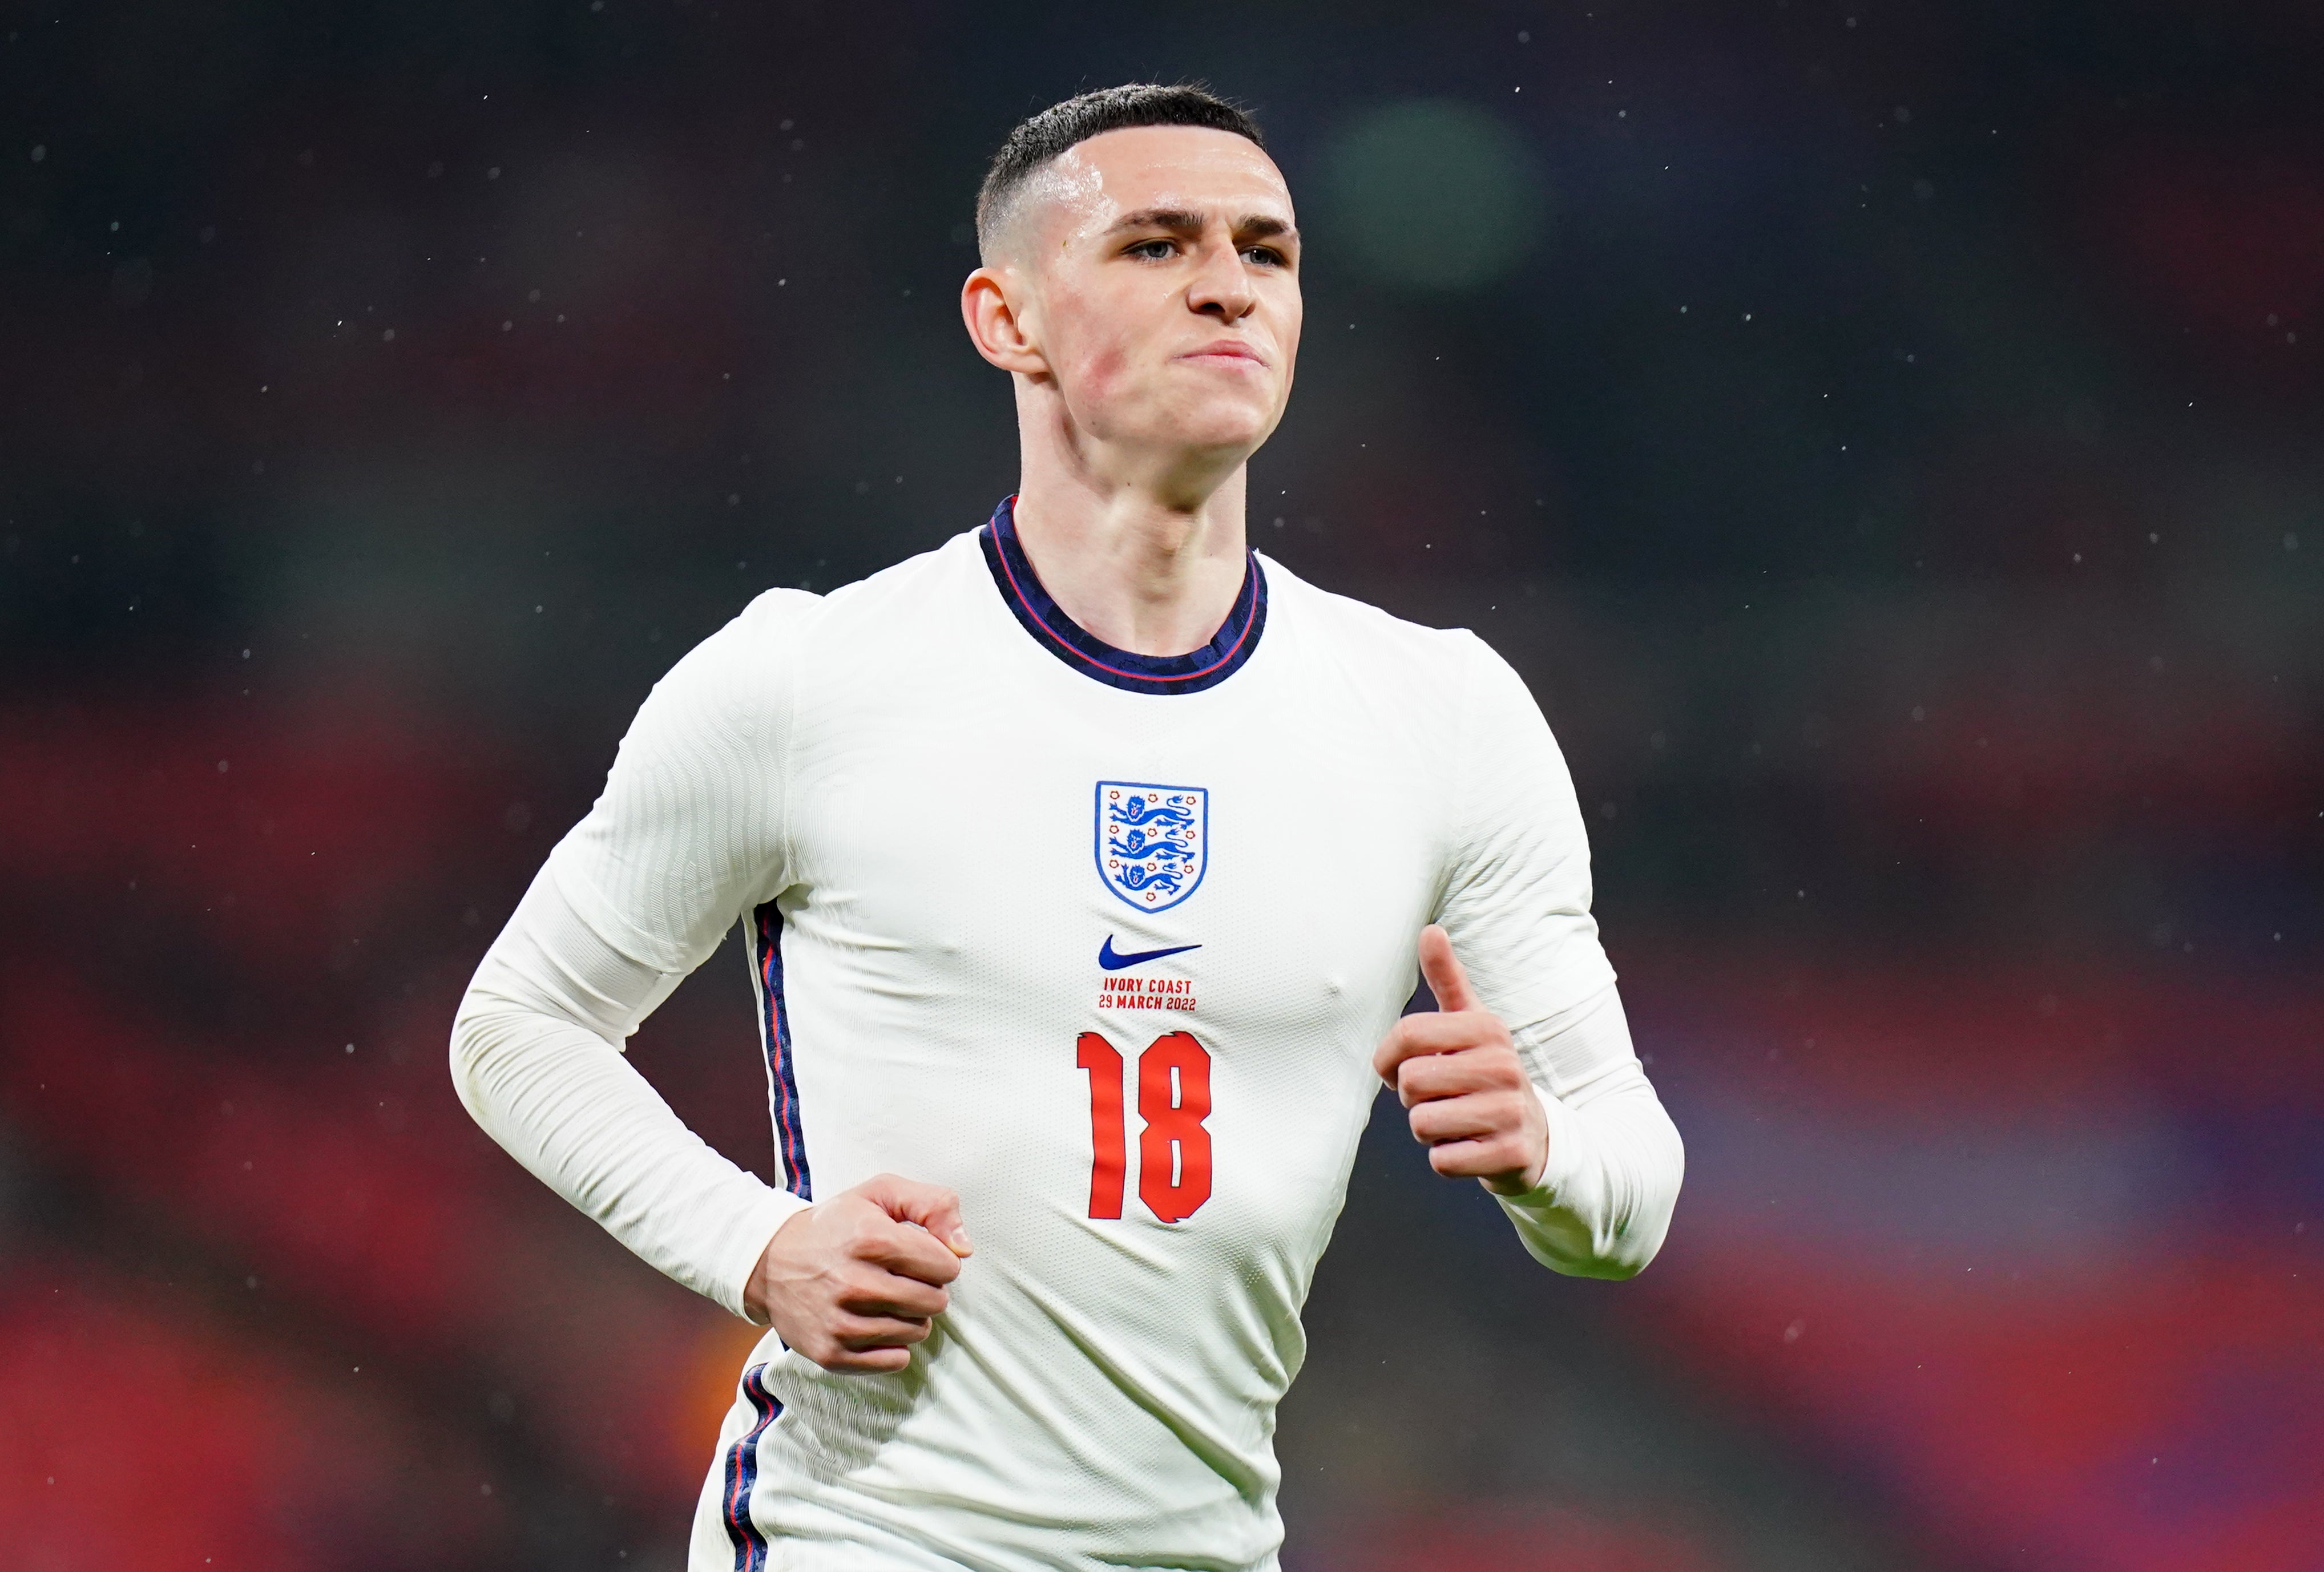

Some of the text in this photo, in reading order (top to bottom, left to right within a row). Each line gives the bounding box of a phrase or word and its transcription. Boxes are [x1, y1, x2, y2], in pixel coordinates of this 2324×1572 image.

[1104, 977, 1192, 994] IVORY COAST
[1099, 995, 1196, 1011] 29 MARCH 2022
[1076, 1031, 1212, 1223] 18
